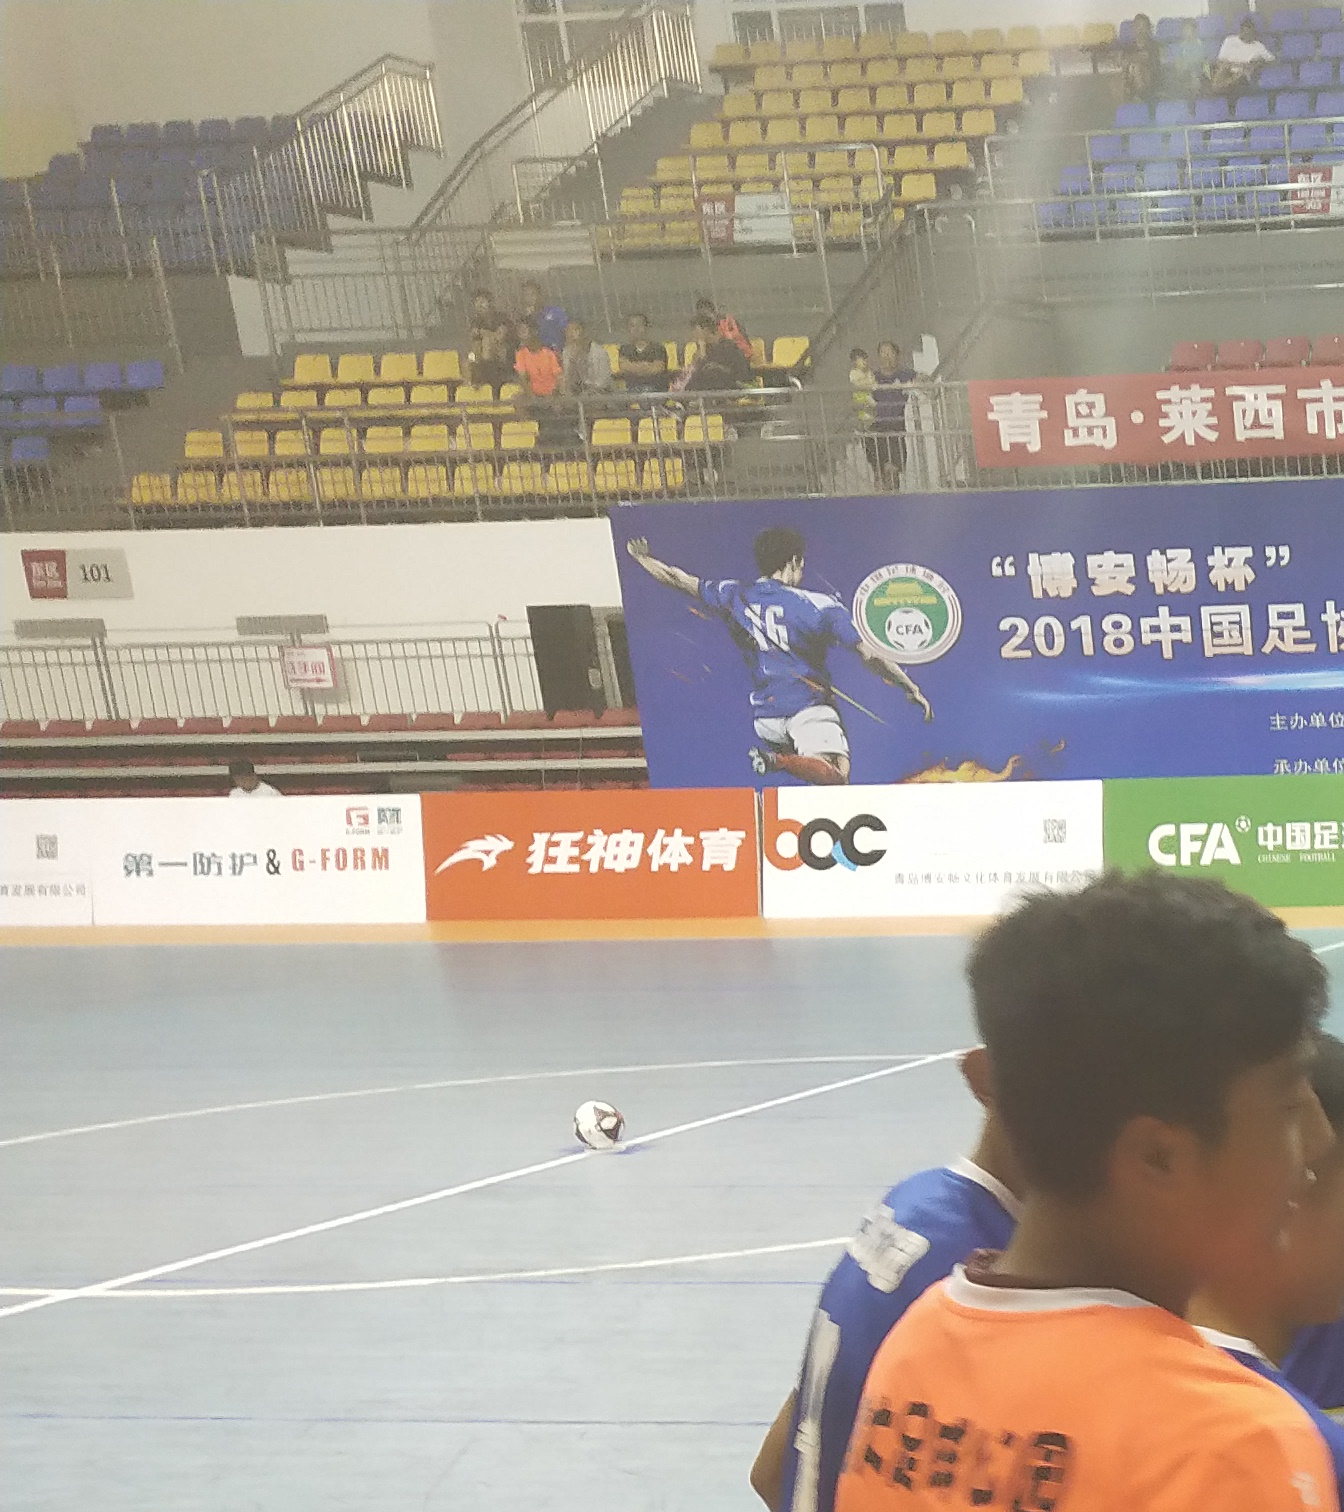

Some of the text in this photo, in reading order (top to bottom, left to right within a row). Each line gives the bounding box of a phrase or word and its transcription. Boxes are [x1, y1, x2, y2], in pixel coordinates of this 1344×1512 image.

[79, 563, 112, 584] 101
[991, 545, 1291, 599] “博安畅杯”
[895, 624, 924, 636] CFA
[266, 849, 281, 876] &
[291, 847, 391, 872] G-FORM
[526, 828, 747, 875] 狂神体育
[1148, 822, 1242, 867] CFA
